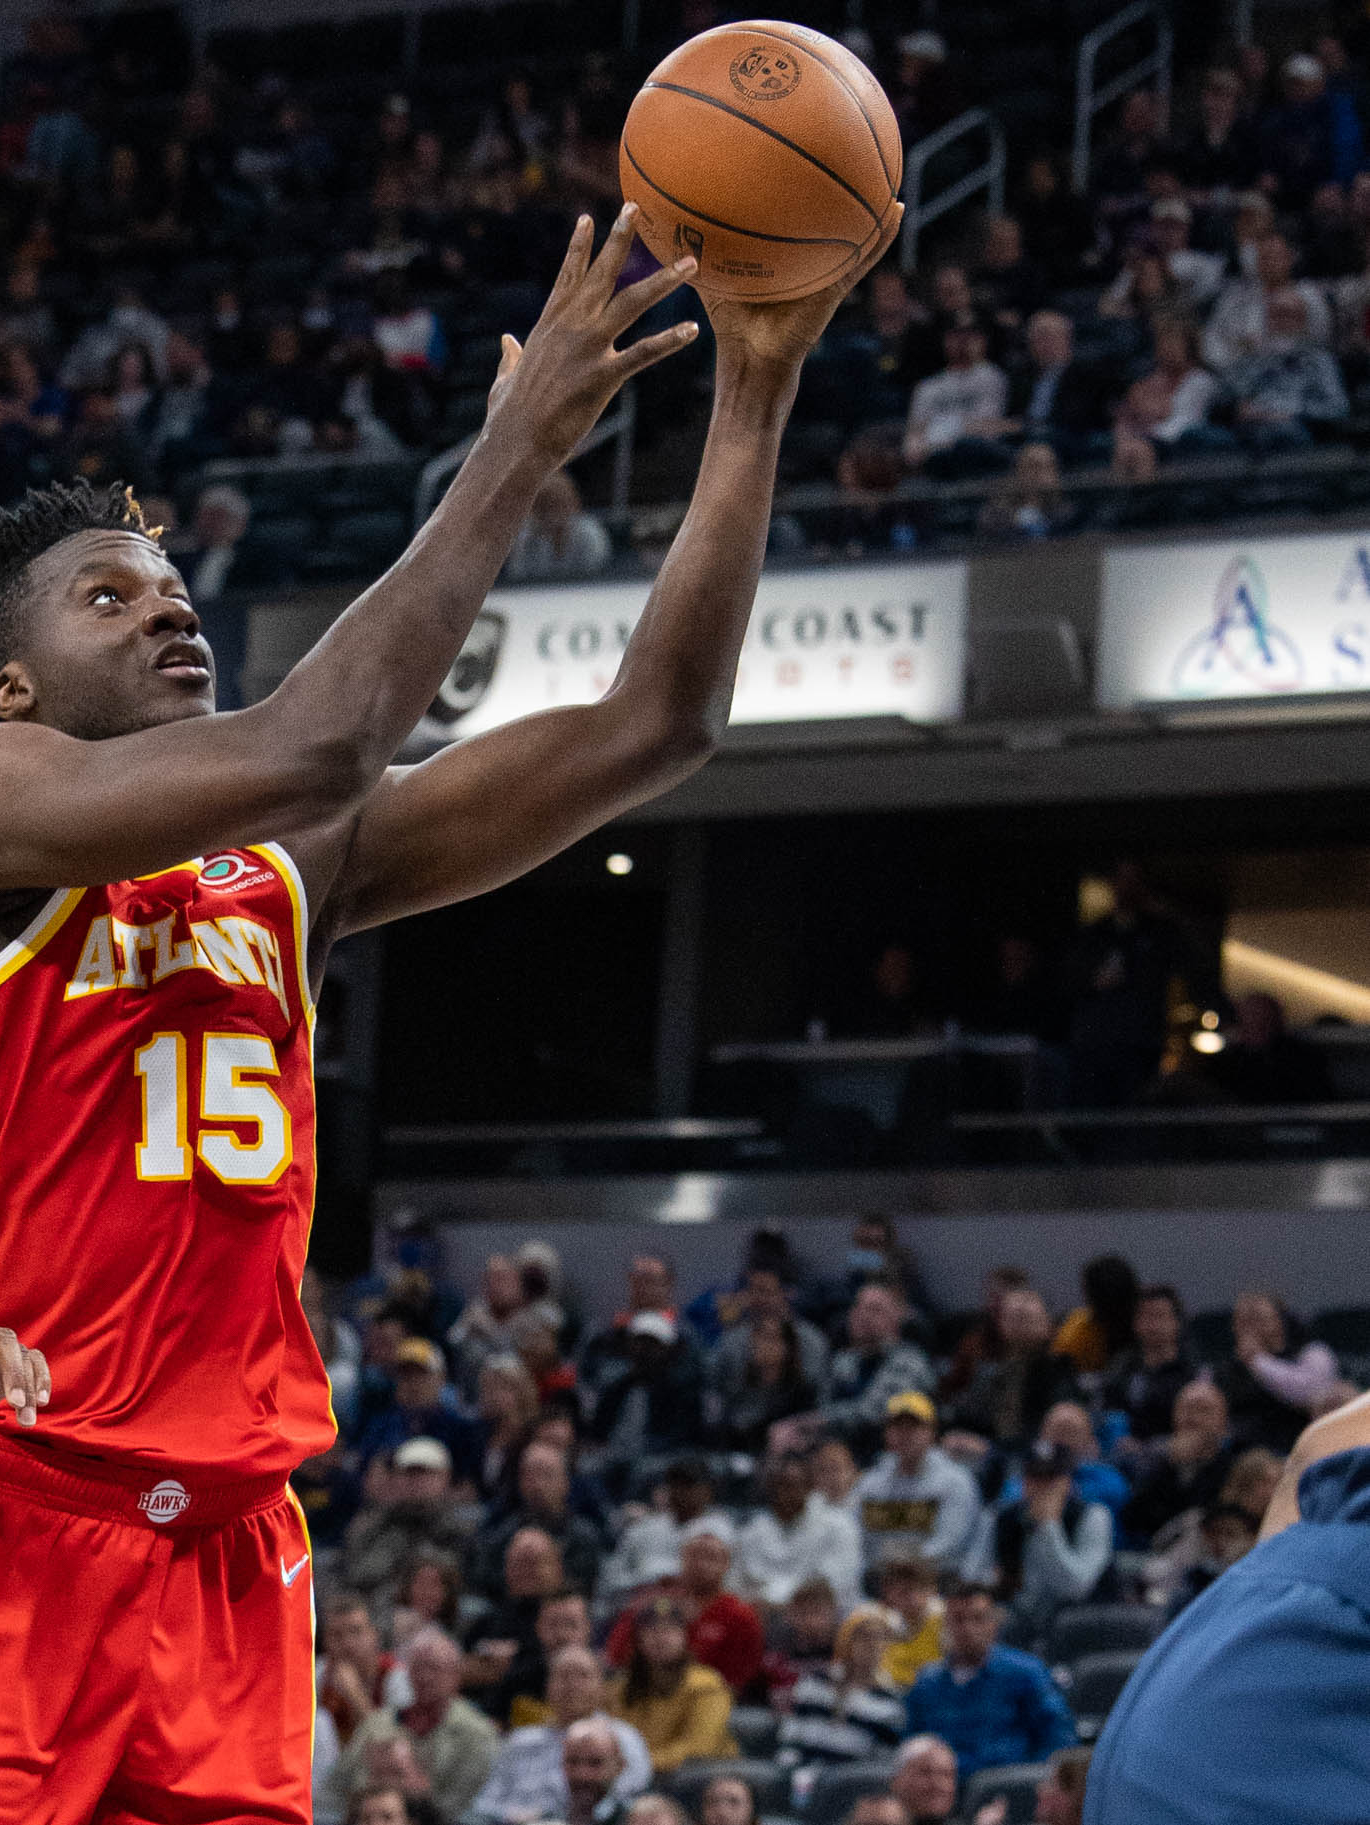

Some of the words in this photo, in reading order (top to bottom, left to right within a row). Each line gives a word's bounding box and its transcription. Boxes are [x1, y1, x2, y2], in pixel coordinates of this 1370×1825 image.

[761, 603, 928, 648] COAST
[133, 1031, 294, 1186] 15
[138, 1492, 191, 1511] HAWKS
